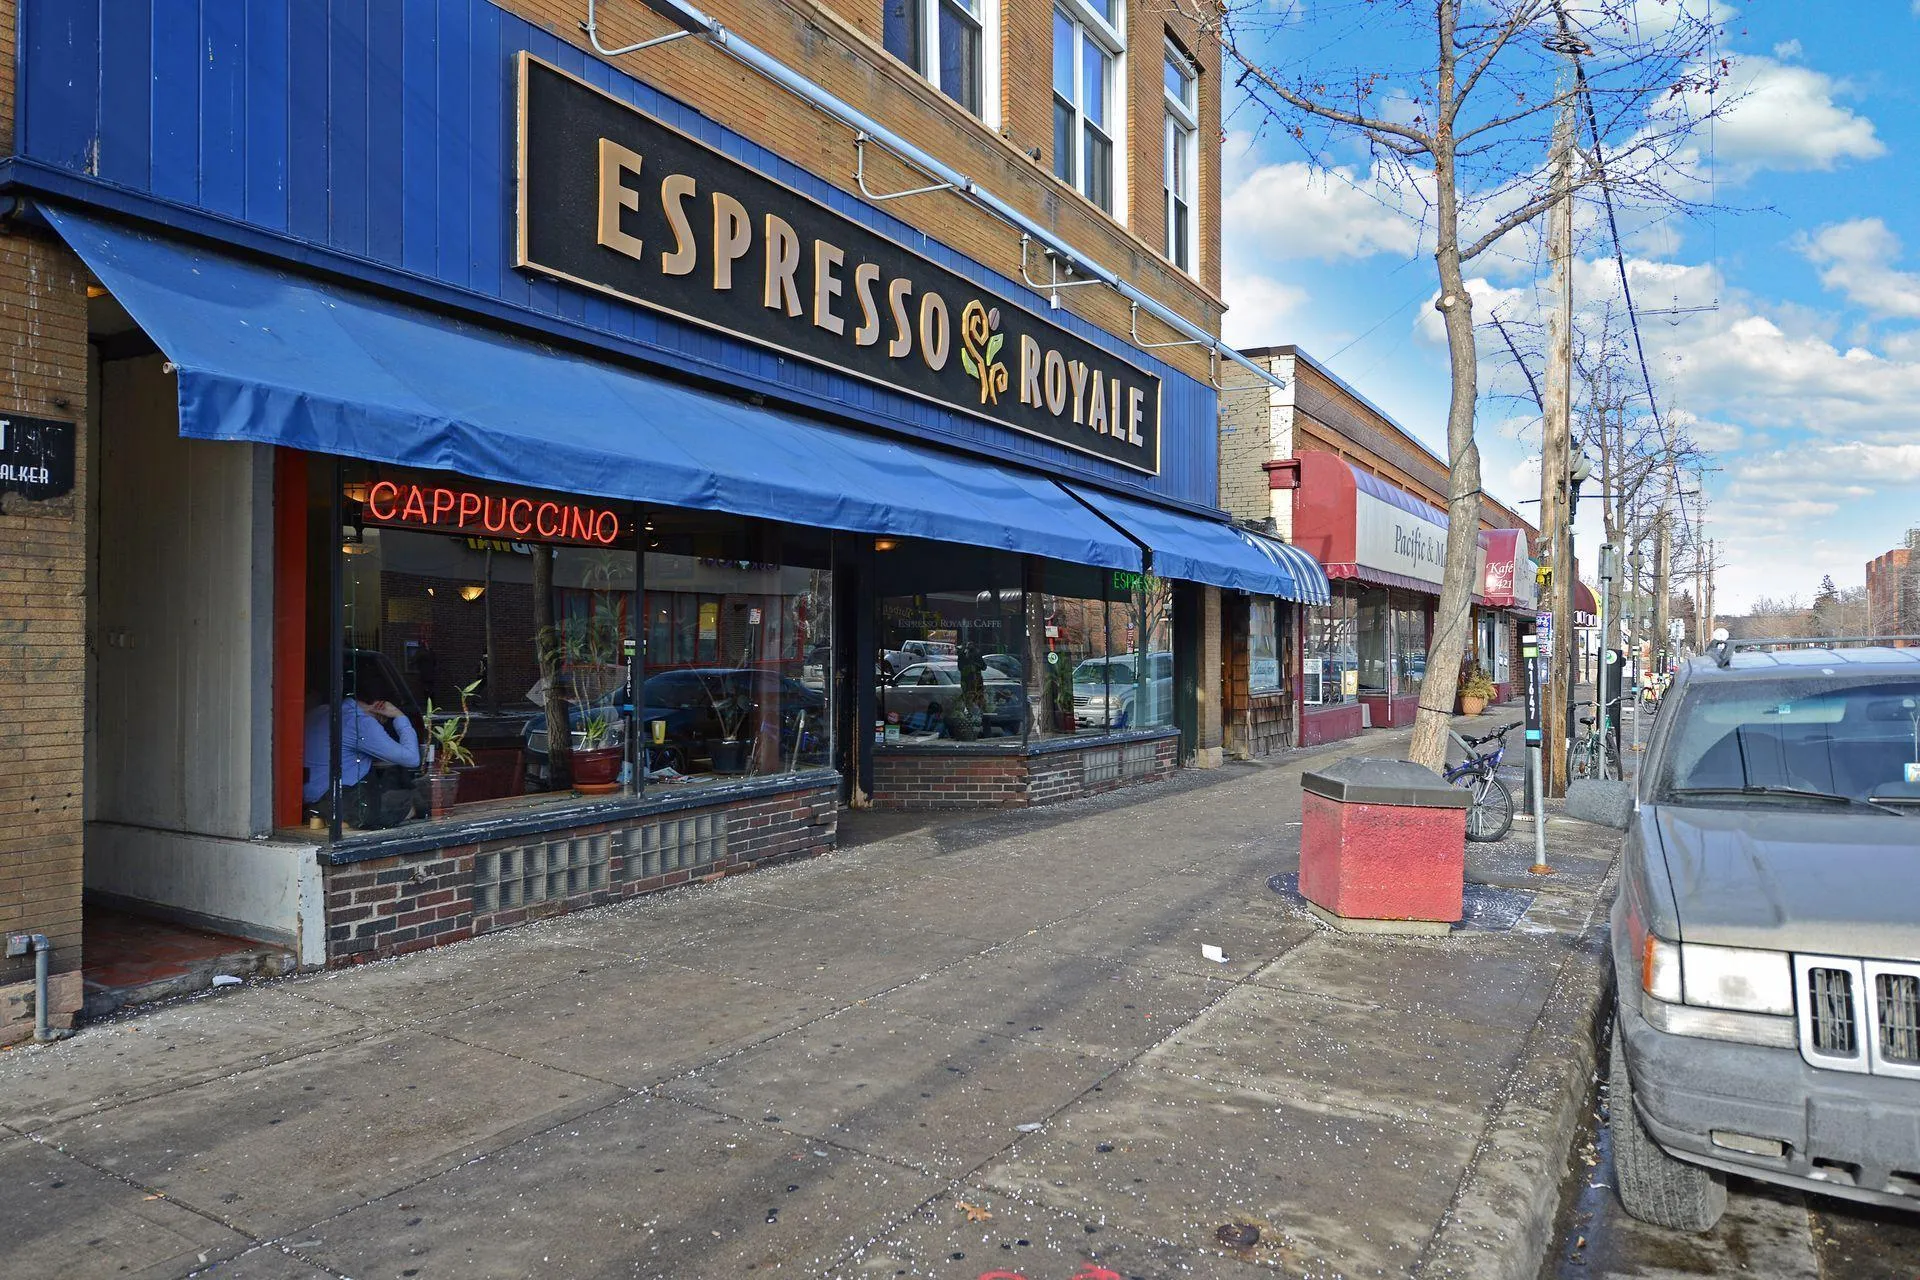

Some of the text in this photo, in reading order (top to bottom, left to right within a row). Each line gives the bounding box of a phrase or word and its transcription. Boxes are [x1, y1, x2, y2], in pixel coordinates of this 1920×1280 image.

[597, 137, 1144, 447] ESPRESSO ROYALE
[369, 481, 619, 544] CAPPUCCINO
[1394, 524, 1425, 568] Pacific
[1427, 536, 1434, 562] &
[1527, 658, 1536, 720] 41647
